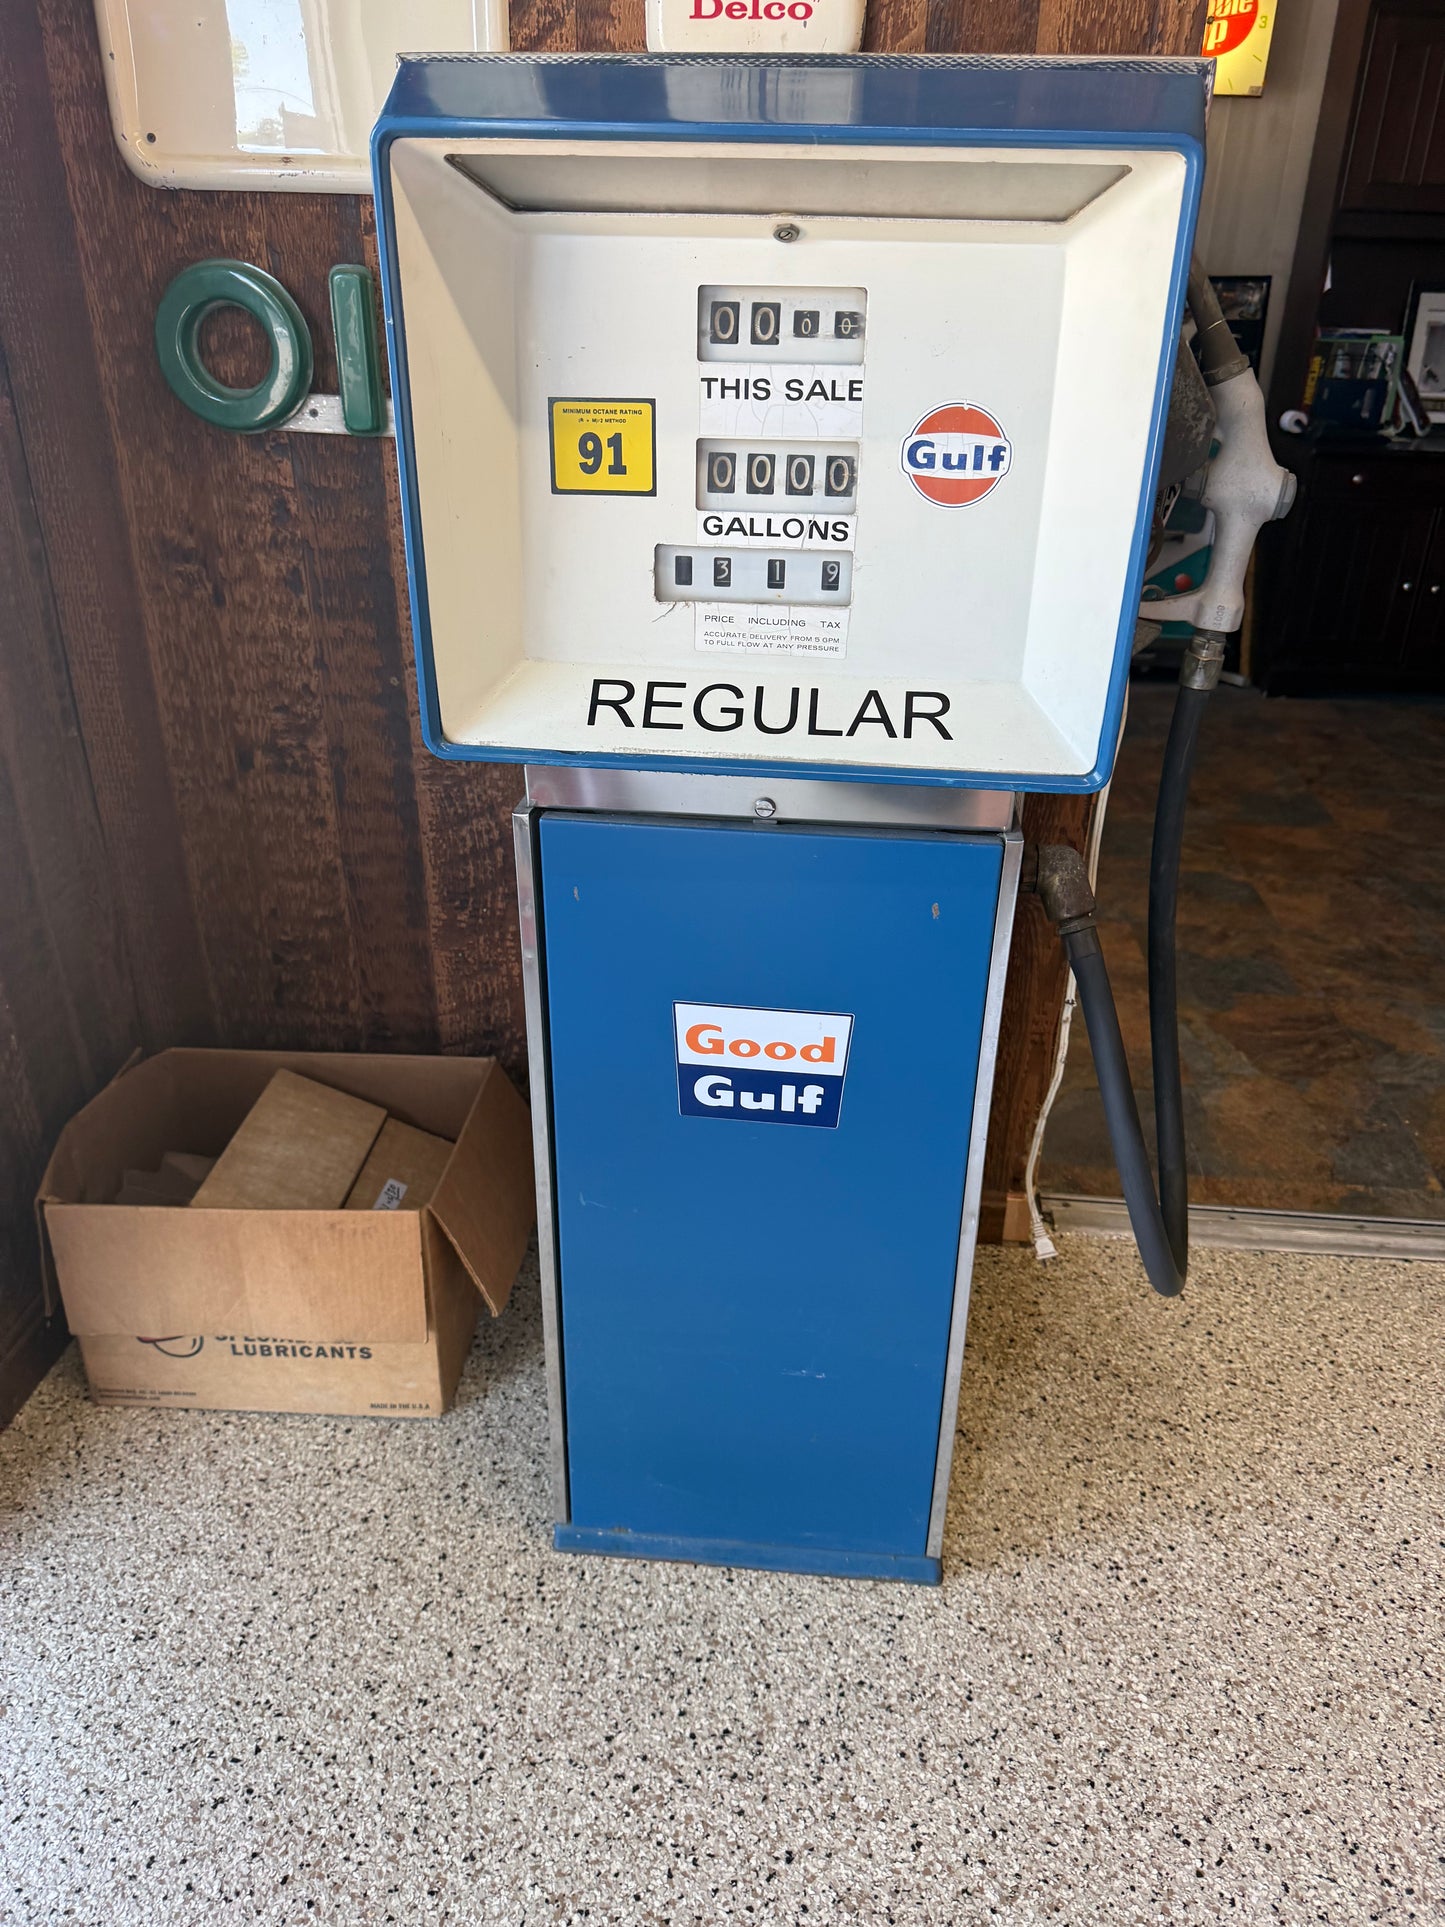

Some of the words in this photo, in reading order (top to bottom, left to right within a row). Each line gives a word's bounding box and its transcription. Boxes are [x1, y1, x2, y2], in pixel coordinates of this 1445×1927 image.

[689, 0, 814, 20] Delco
[1259, 16, 1268, 29] 3
[700, 377, 771, 401] THIS
[784, 378, 863, 402] SALE
[578, 431, 627, 475] 91
[907, 439, 1007, 472] Gulf
[703, 515, 849, 542] GALLONS
[704, 614, 735, 624] PRICE
[748, 617, 806, 627] INCLUDING
[820, 620, 841, 629] TAX
[704, 631, 747, 639] ACCURATE
[749, 633, 788, 641] DELIVERY
[796, 644, 840, 652] PRESSURE
[586, 678, 954, 741] REGULAR
[685, 1023, 836, 1063] Good
[693, 1074, 825, 1114] Gulf
[230, 1343, 373, 1360] LUBRICANTS
